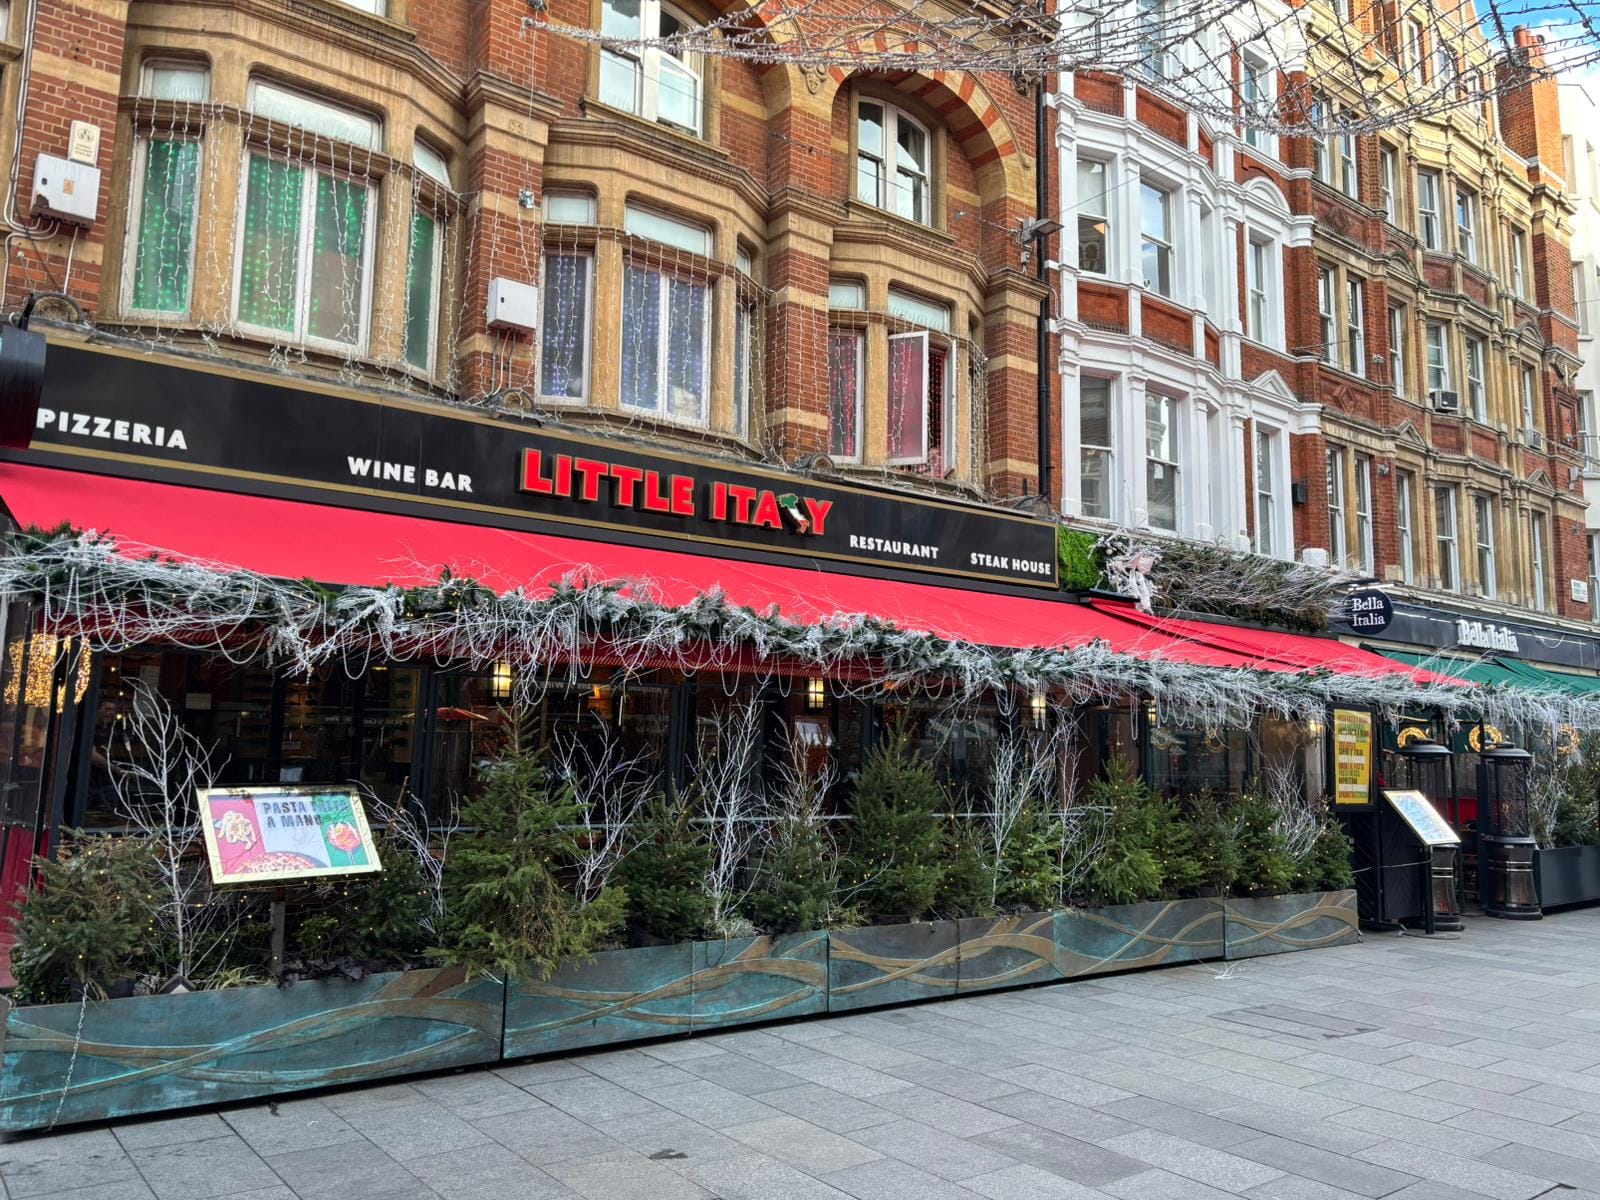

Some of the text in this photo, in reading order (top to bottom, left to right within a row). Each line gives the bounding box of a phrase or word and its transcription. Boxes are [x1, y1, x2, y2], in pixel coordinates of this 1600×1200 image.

[36, 407, 188, 450] PIZZERIA
[347, 456, 473, 493] WINE BAR
[519, 447, 696, 516] LITTLE
[849, 534, 940, 560] RESTAURANT
[970, 552, 1051, 575] STEAK HOUSE
[1352, 597, 1385, 612] Bella
[1352, 612, 1386, 627] Italia
[263, 801, 307, 815] PASTA
[267, 815, 277, 829] A
